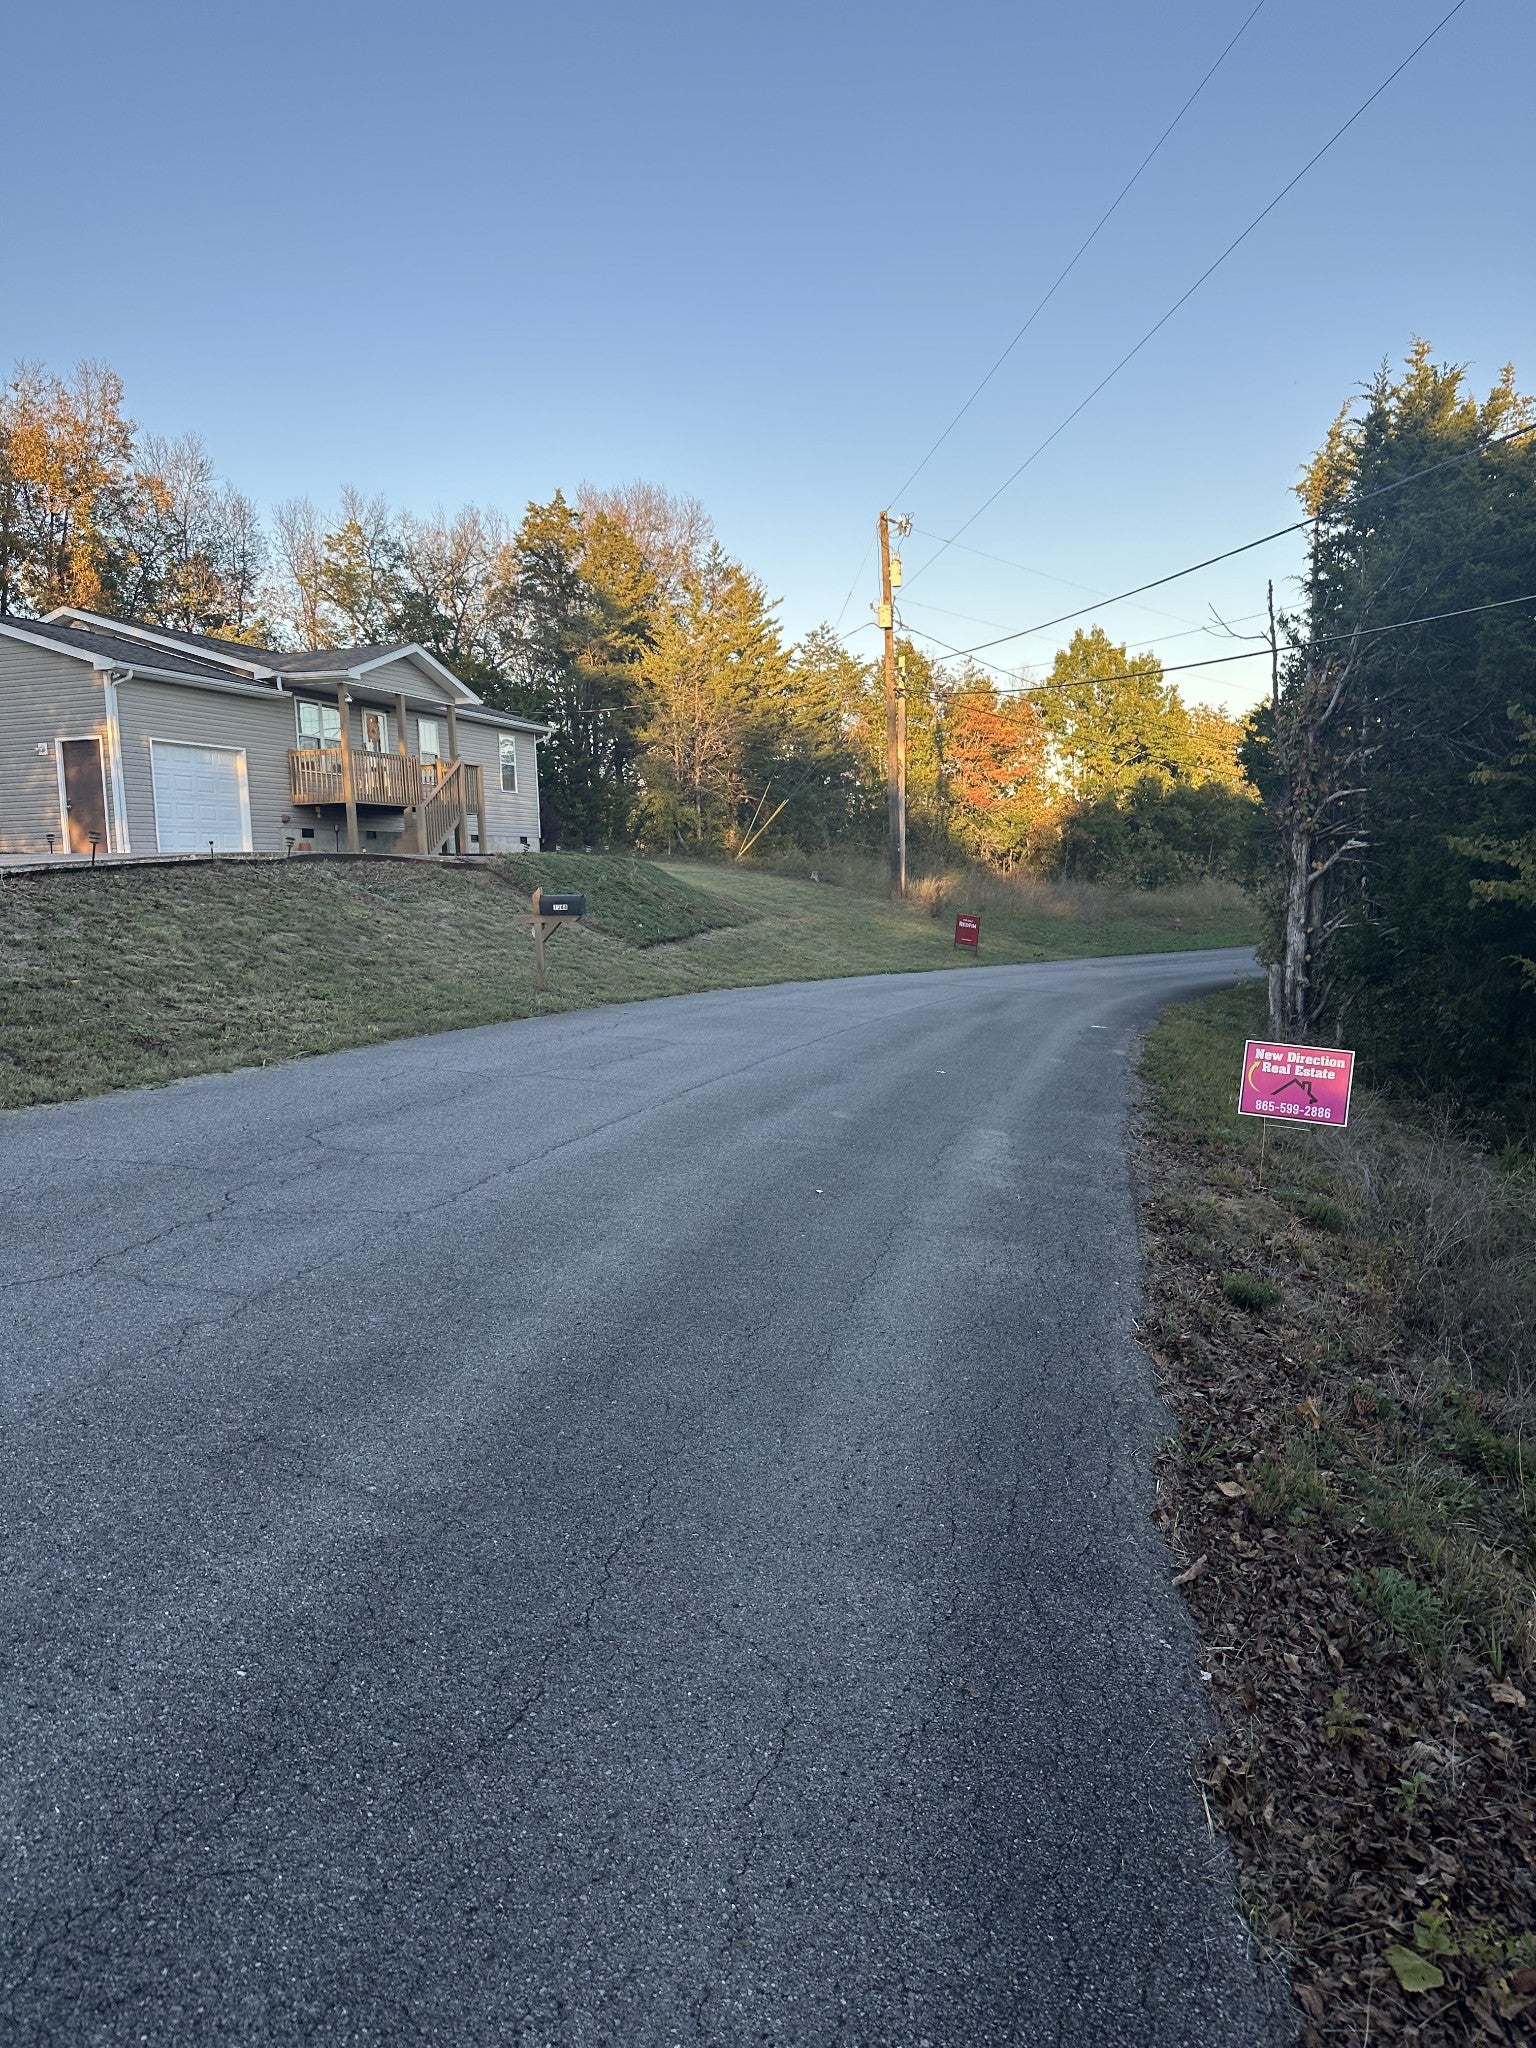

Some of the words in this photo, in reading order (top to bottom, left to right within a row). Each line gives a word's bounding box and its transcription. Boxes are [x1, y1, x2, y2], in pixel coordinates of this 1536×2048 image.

[1255, 1048, 1284, 1062] New
[1287, 1051, 1346, 1069] Direction
[1262, 1061, 1291, 1075] Real
[1294, 1065, 1336, 1080] Estate
[1255, 1099, 1332, 1119] 865-599-2886
